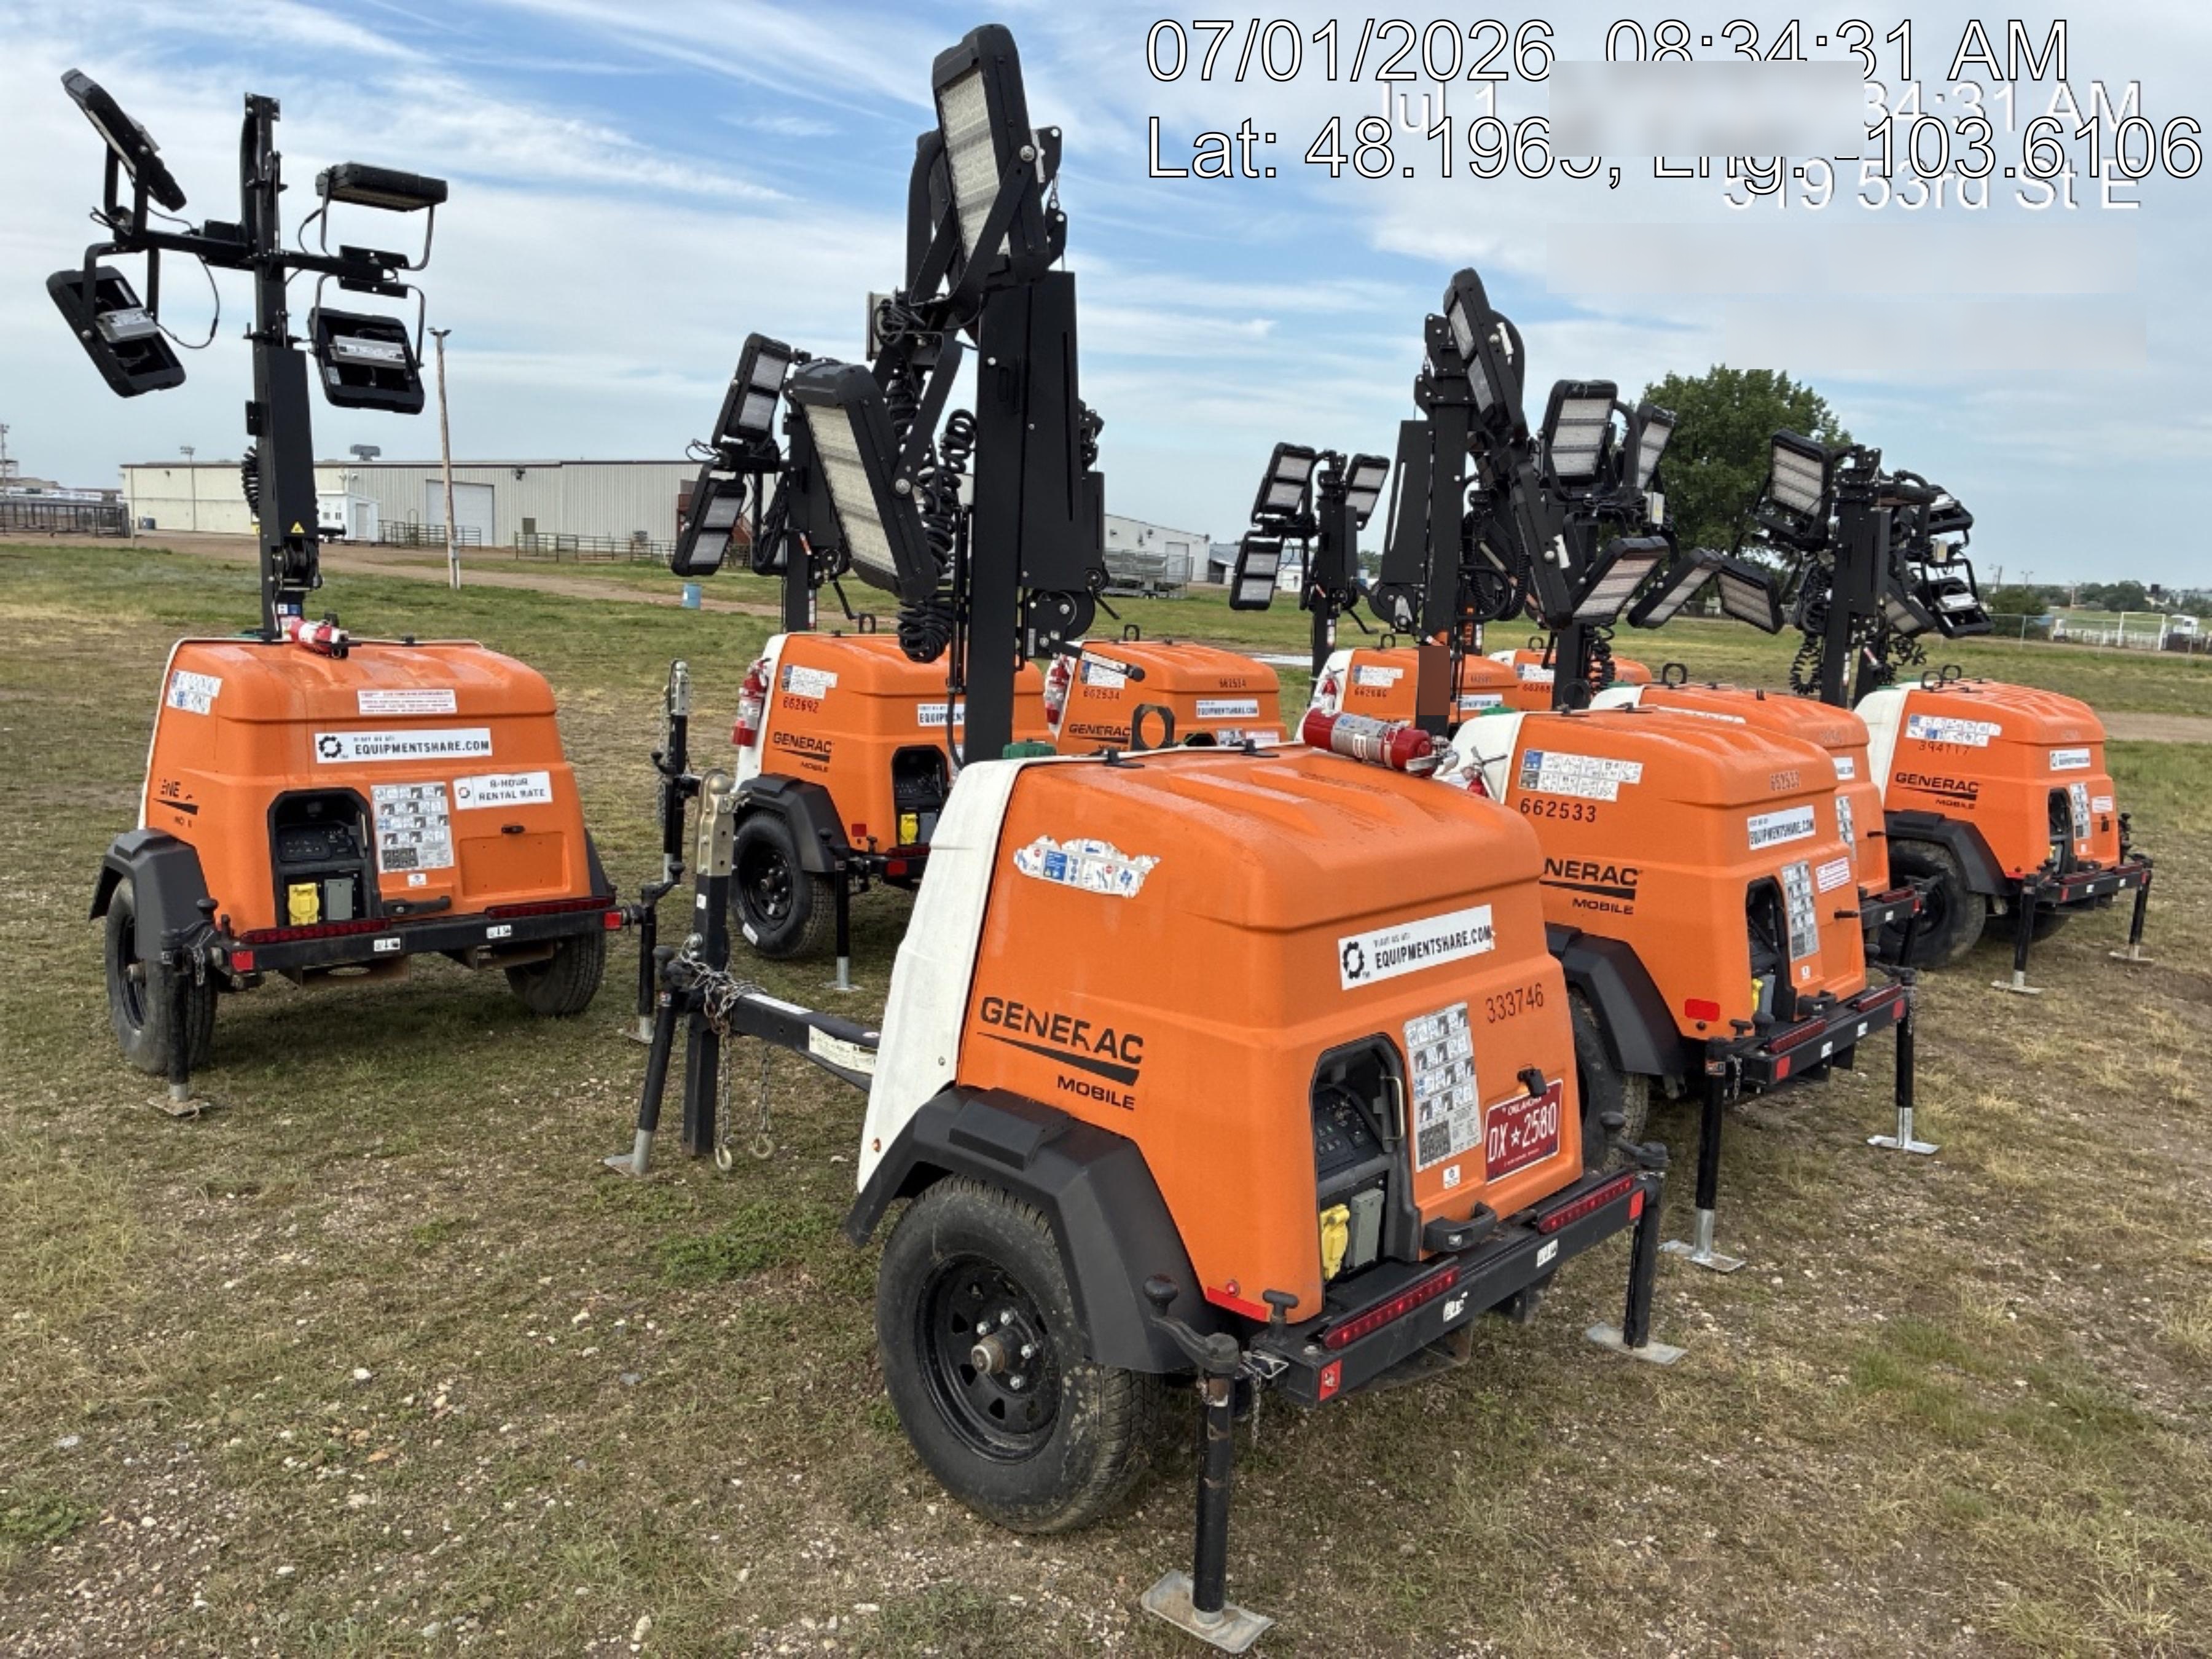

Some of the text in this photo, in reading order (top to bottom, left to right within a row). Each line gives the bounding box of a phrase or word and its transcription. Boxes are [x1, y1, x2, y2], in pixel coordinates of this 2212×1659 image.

[773, 732, 832, 753] GENERAC
[1069, 724, 1131, 736] GENERAC
[355, 740, 490, 755] EQUIPMENTSHARE.COM
[1896, 772, 1979, 793] GENERAC
[479, 790, 517, 801] RENTAL
[1520, 798, 1597, 823] 662533
[1543, 858, 1638, 886] NERAC
[1572, 898, 1634, 915] MOBILE
[1375, 925, 1491, 970] EQUIPMENTSHARE.COM
[1486, 982, 1543, 1024] 333746
[981, 996, 1143, 1064] GENERAC
[1057, 1075, 1135, 1111] MOBILE
[1488, 1122, 1508, 1163] DX
[1522, 1102, 1557, 1148] 2580
